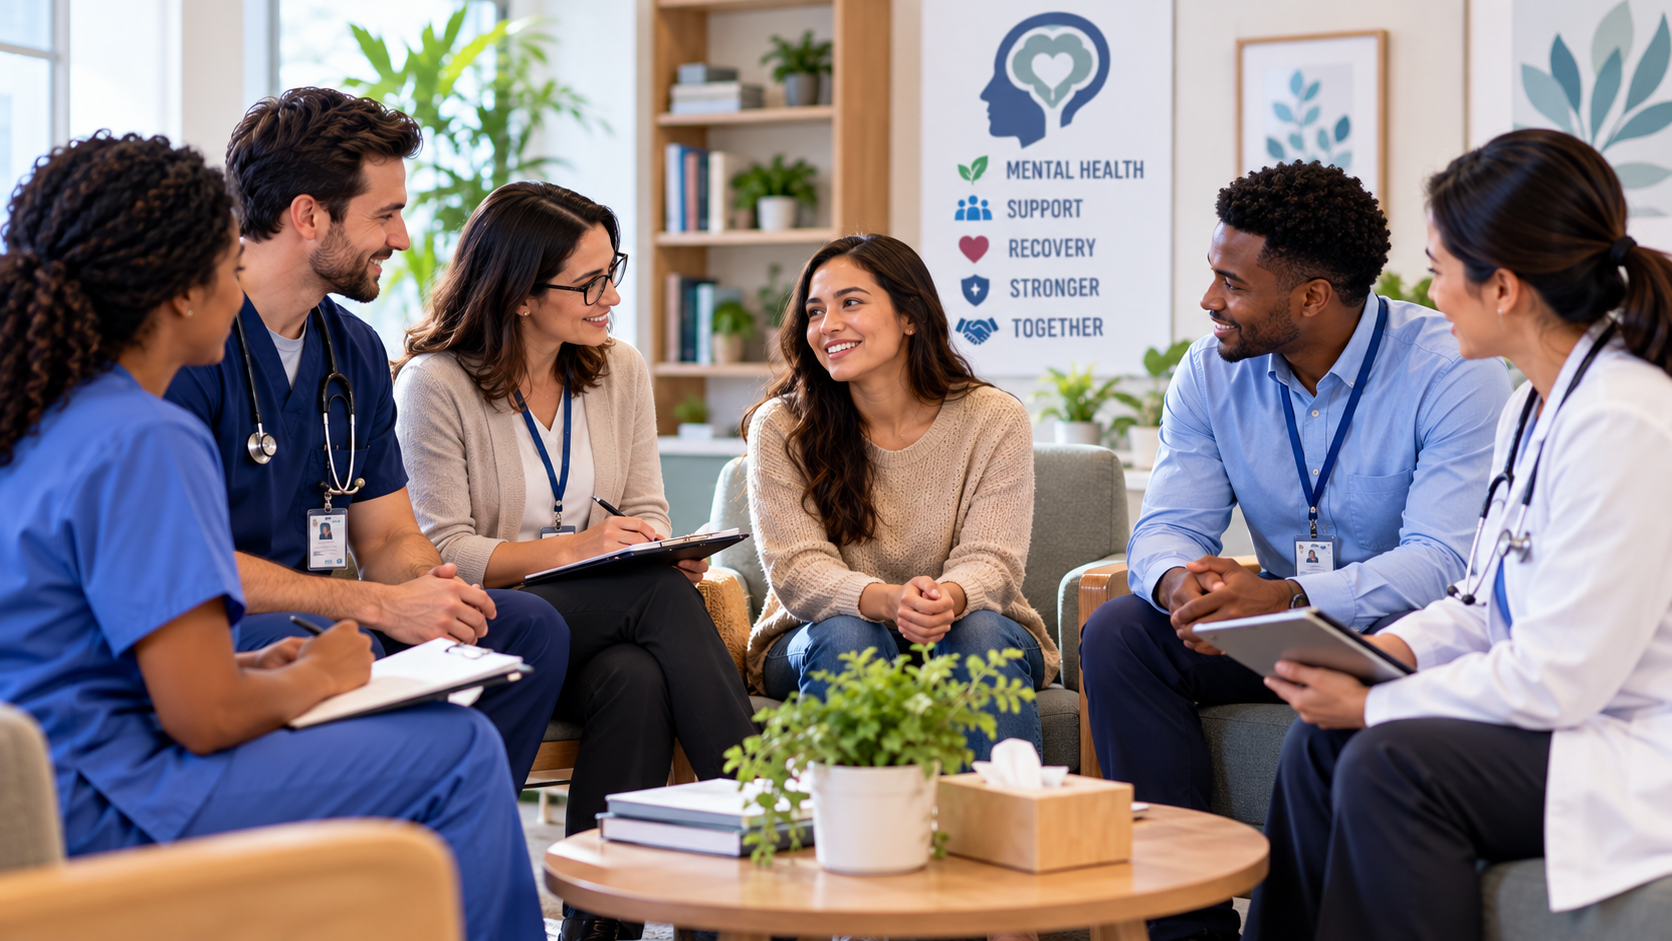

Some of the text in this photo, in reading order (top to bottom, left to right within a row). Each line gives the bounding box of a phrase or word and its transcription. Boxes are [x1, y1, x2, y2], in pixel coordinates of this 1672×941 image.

[1006, 159, 1145, 180] MENTAL HEALTH
[1007, 199, 1083, 219] SUPPORT
[1008, 238, 1096, 258] RECOVERY
[1010, 277, 1100, 298] STRONGER
[1012, 317, 1104, 339] TOGETHER
